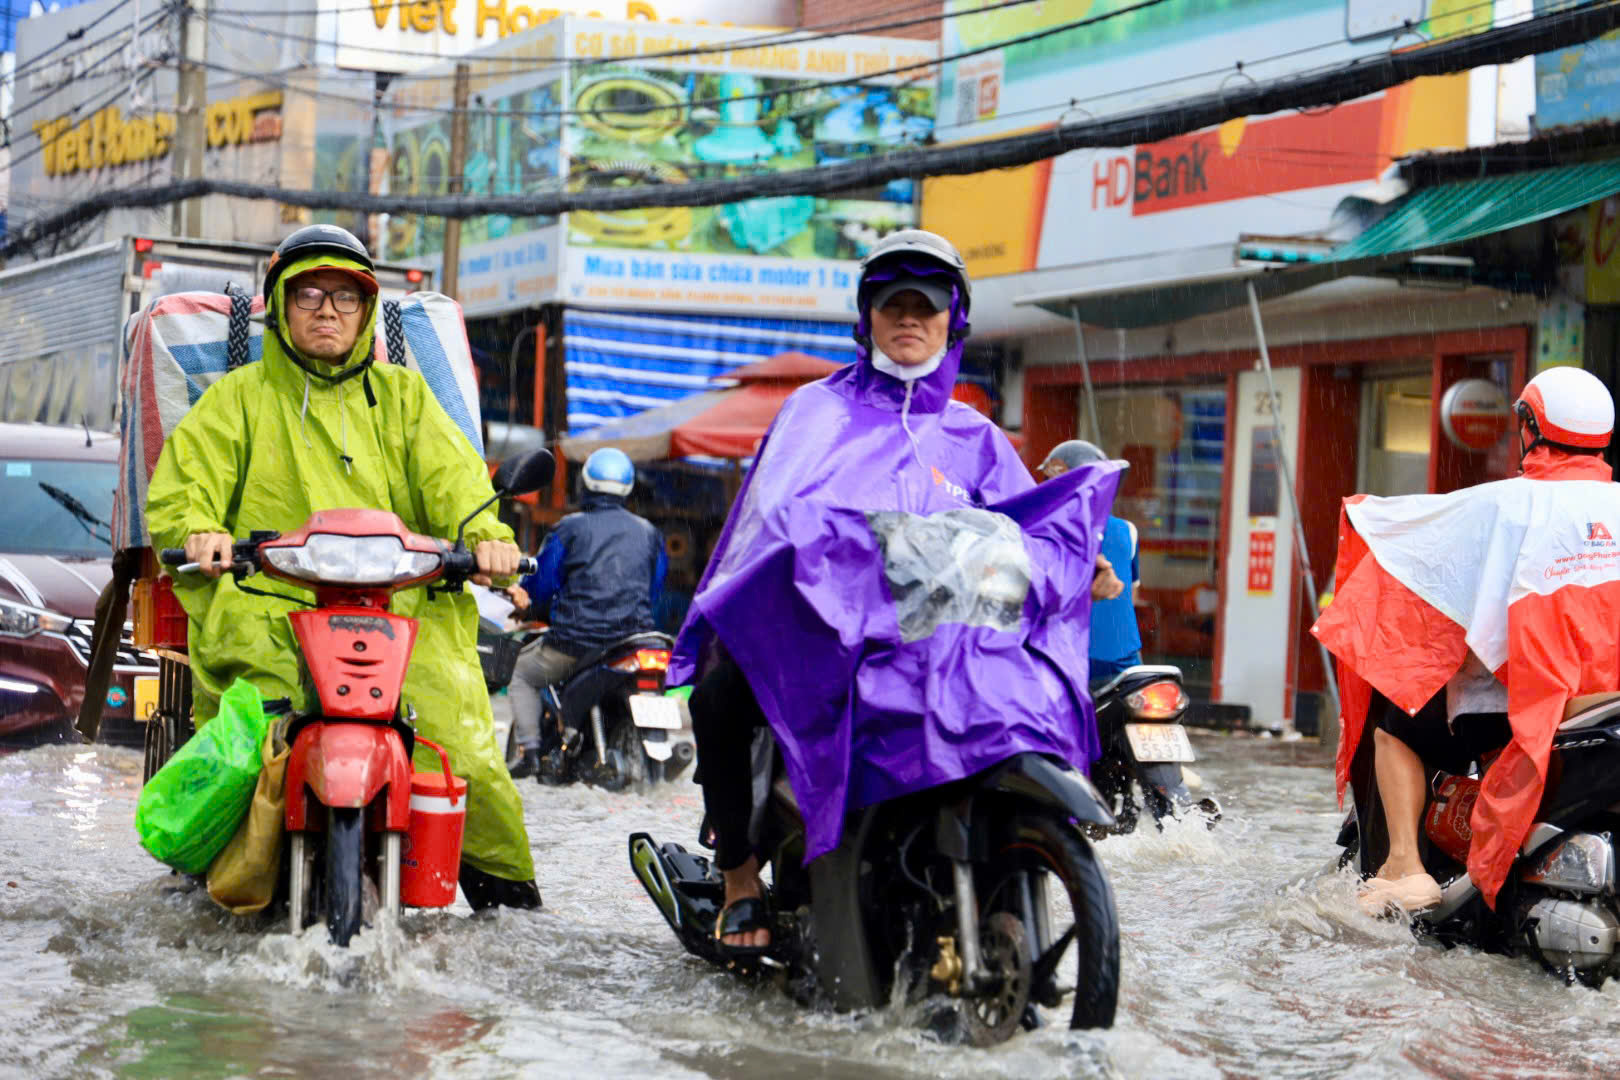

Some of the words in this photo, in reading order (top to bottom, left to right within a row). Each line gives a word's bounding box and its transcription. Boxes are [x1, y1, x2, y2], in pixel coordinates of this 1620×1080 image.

[1091, 141, 1210, 212] HDBank
[584, 255, 625, 277] Mua
[630, 257, 664, 280] bán
